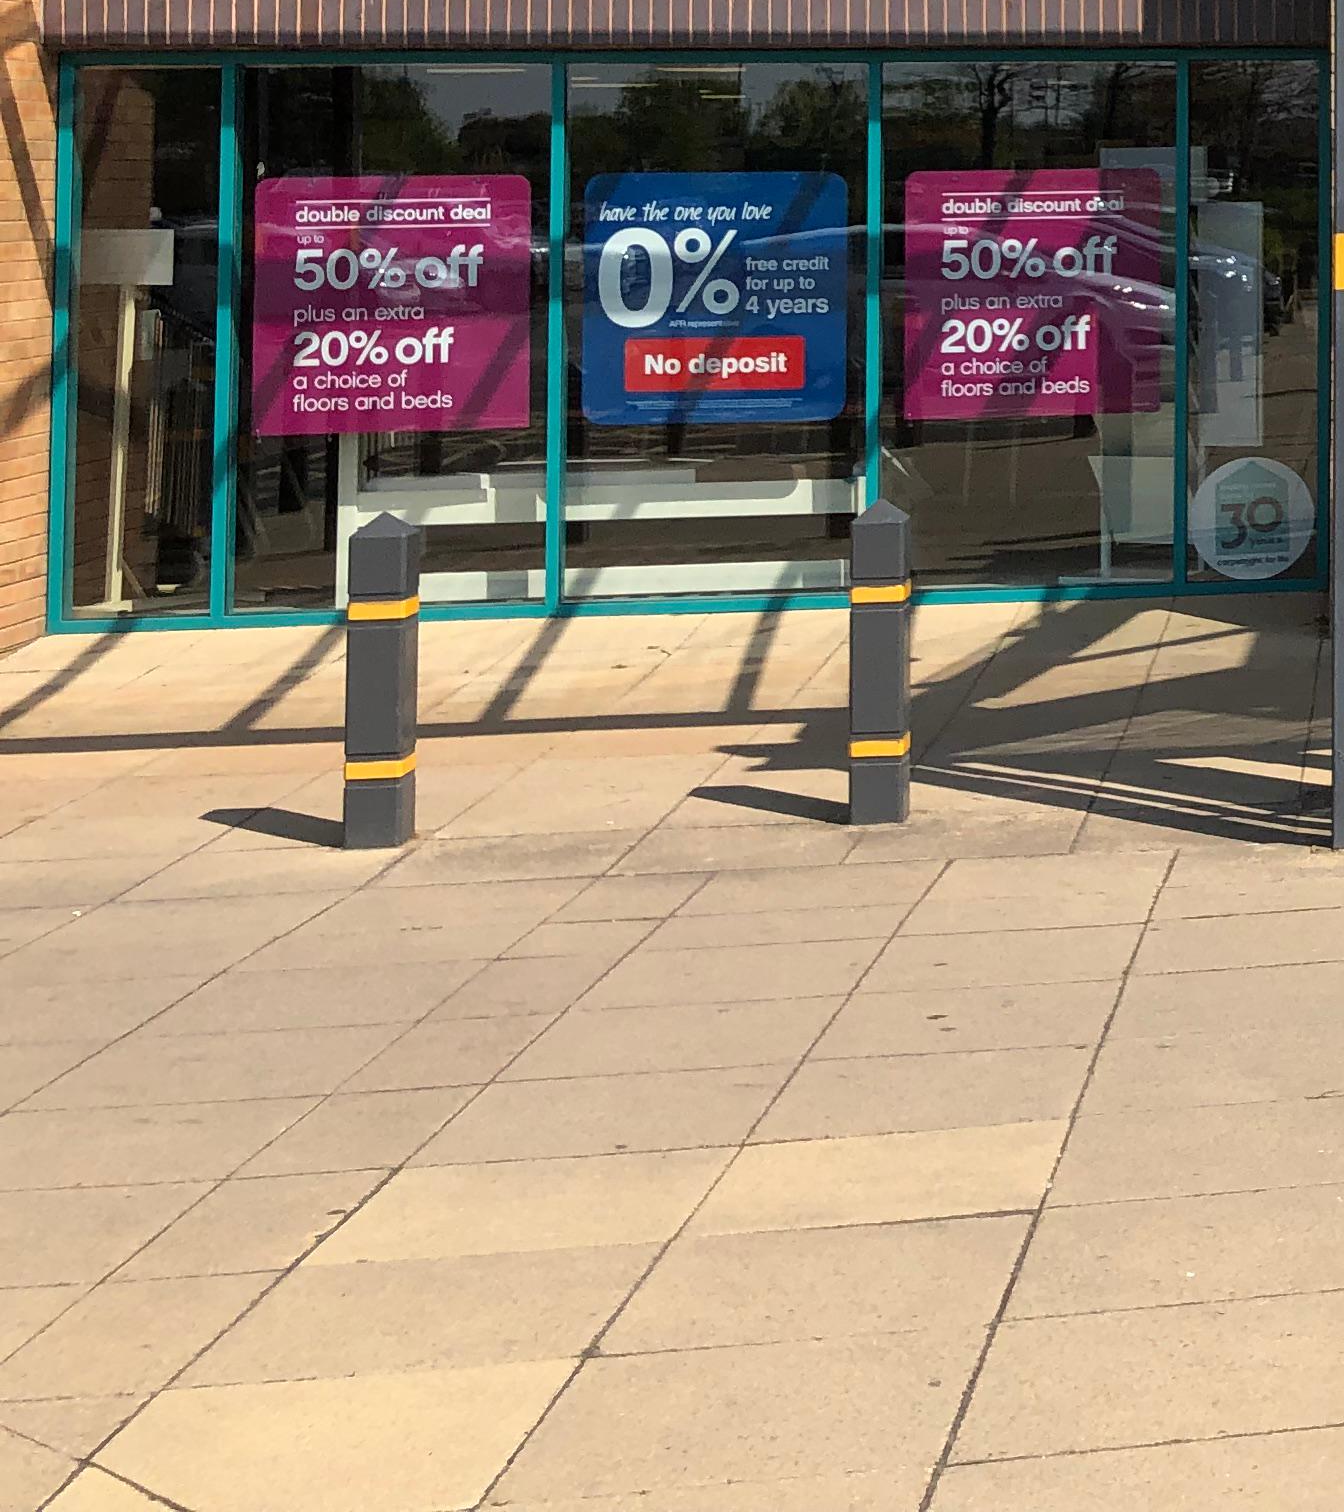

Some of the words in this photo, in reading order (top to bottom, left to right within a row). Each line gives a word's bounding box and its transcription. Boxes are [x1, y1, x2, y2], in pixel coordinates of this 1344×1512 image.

[296, 205, 360, 223] double
[366, 205, 444, 222] discount
[450, 204, 491, 220] deal
[600, 201, 636, 221] have
[643, 201, 668, 221] the
[674, 206, 703, 220] one
[708, 206, 736, 225] you
[742, 202, 772, 220] love
[942, 199, 1002, 214] double
[1007, 198, 1081, 213] discount
[297, 235, 311, 245] up
[314, 235, 324, 244] to
[294, 248, 406, 290] 50%
[415, 244, 483, 289] off
[746, 257, 777, 270] free
[783, 256, 829, 270] credit
[941, 238, 1046, 280] 50%
[1053, 235, 1117, 278] off
[598, 227, 740, 328] 0%
[746, 277, 768, 290] for
[774, 279, 795, 294] up
[799, 277, 815, 290] to
[746, 296, 759, 313] 4
[766, 298, 829, 318] years
[941, 293, 980, 314] plus
[985, 296, 1010, 309] an
[1016, 295, 1063, 309] extra
[294, 304, 335, 327] plus
[342, 307, 368, 322] an
[375, 304, 424, 321] extra
[940, 318, 1029, 354] 20%
[1036, 315, 1090, 350] off
[293, 330, 389, 367] 20%
[395, 326, 454, 365] off
[645, 354, 681, 375] No
[689, 352, 787, 378] deposit
[941, 363, 954, 376] a
[960, 358, 1023, 375] choice
[1029, 356, 1048, 373] of
[293, 376, 307, 389] a
[314, 371, 381, 389] choice
[387, 369, 407, 388] of
[942, 380, 993, 397] floors
[999, 378, 1035, 395] and
[1041, 376, 1090, 394] beds
[293, 394, 349, 412] floors
[355, 392, 394, 410] and
[402, 390, 453, 409] beds
[1221, 496, 1283, 549] 30
